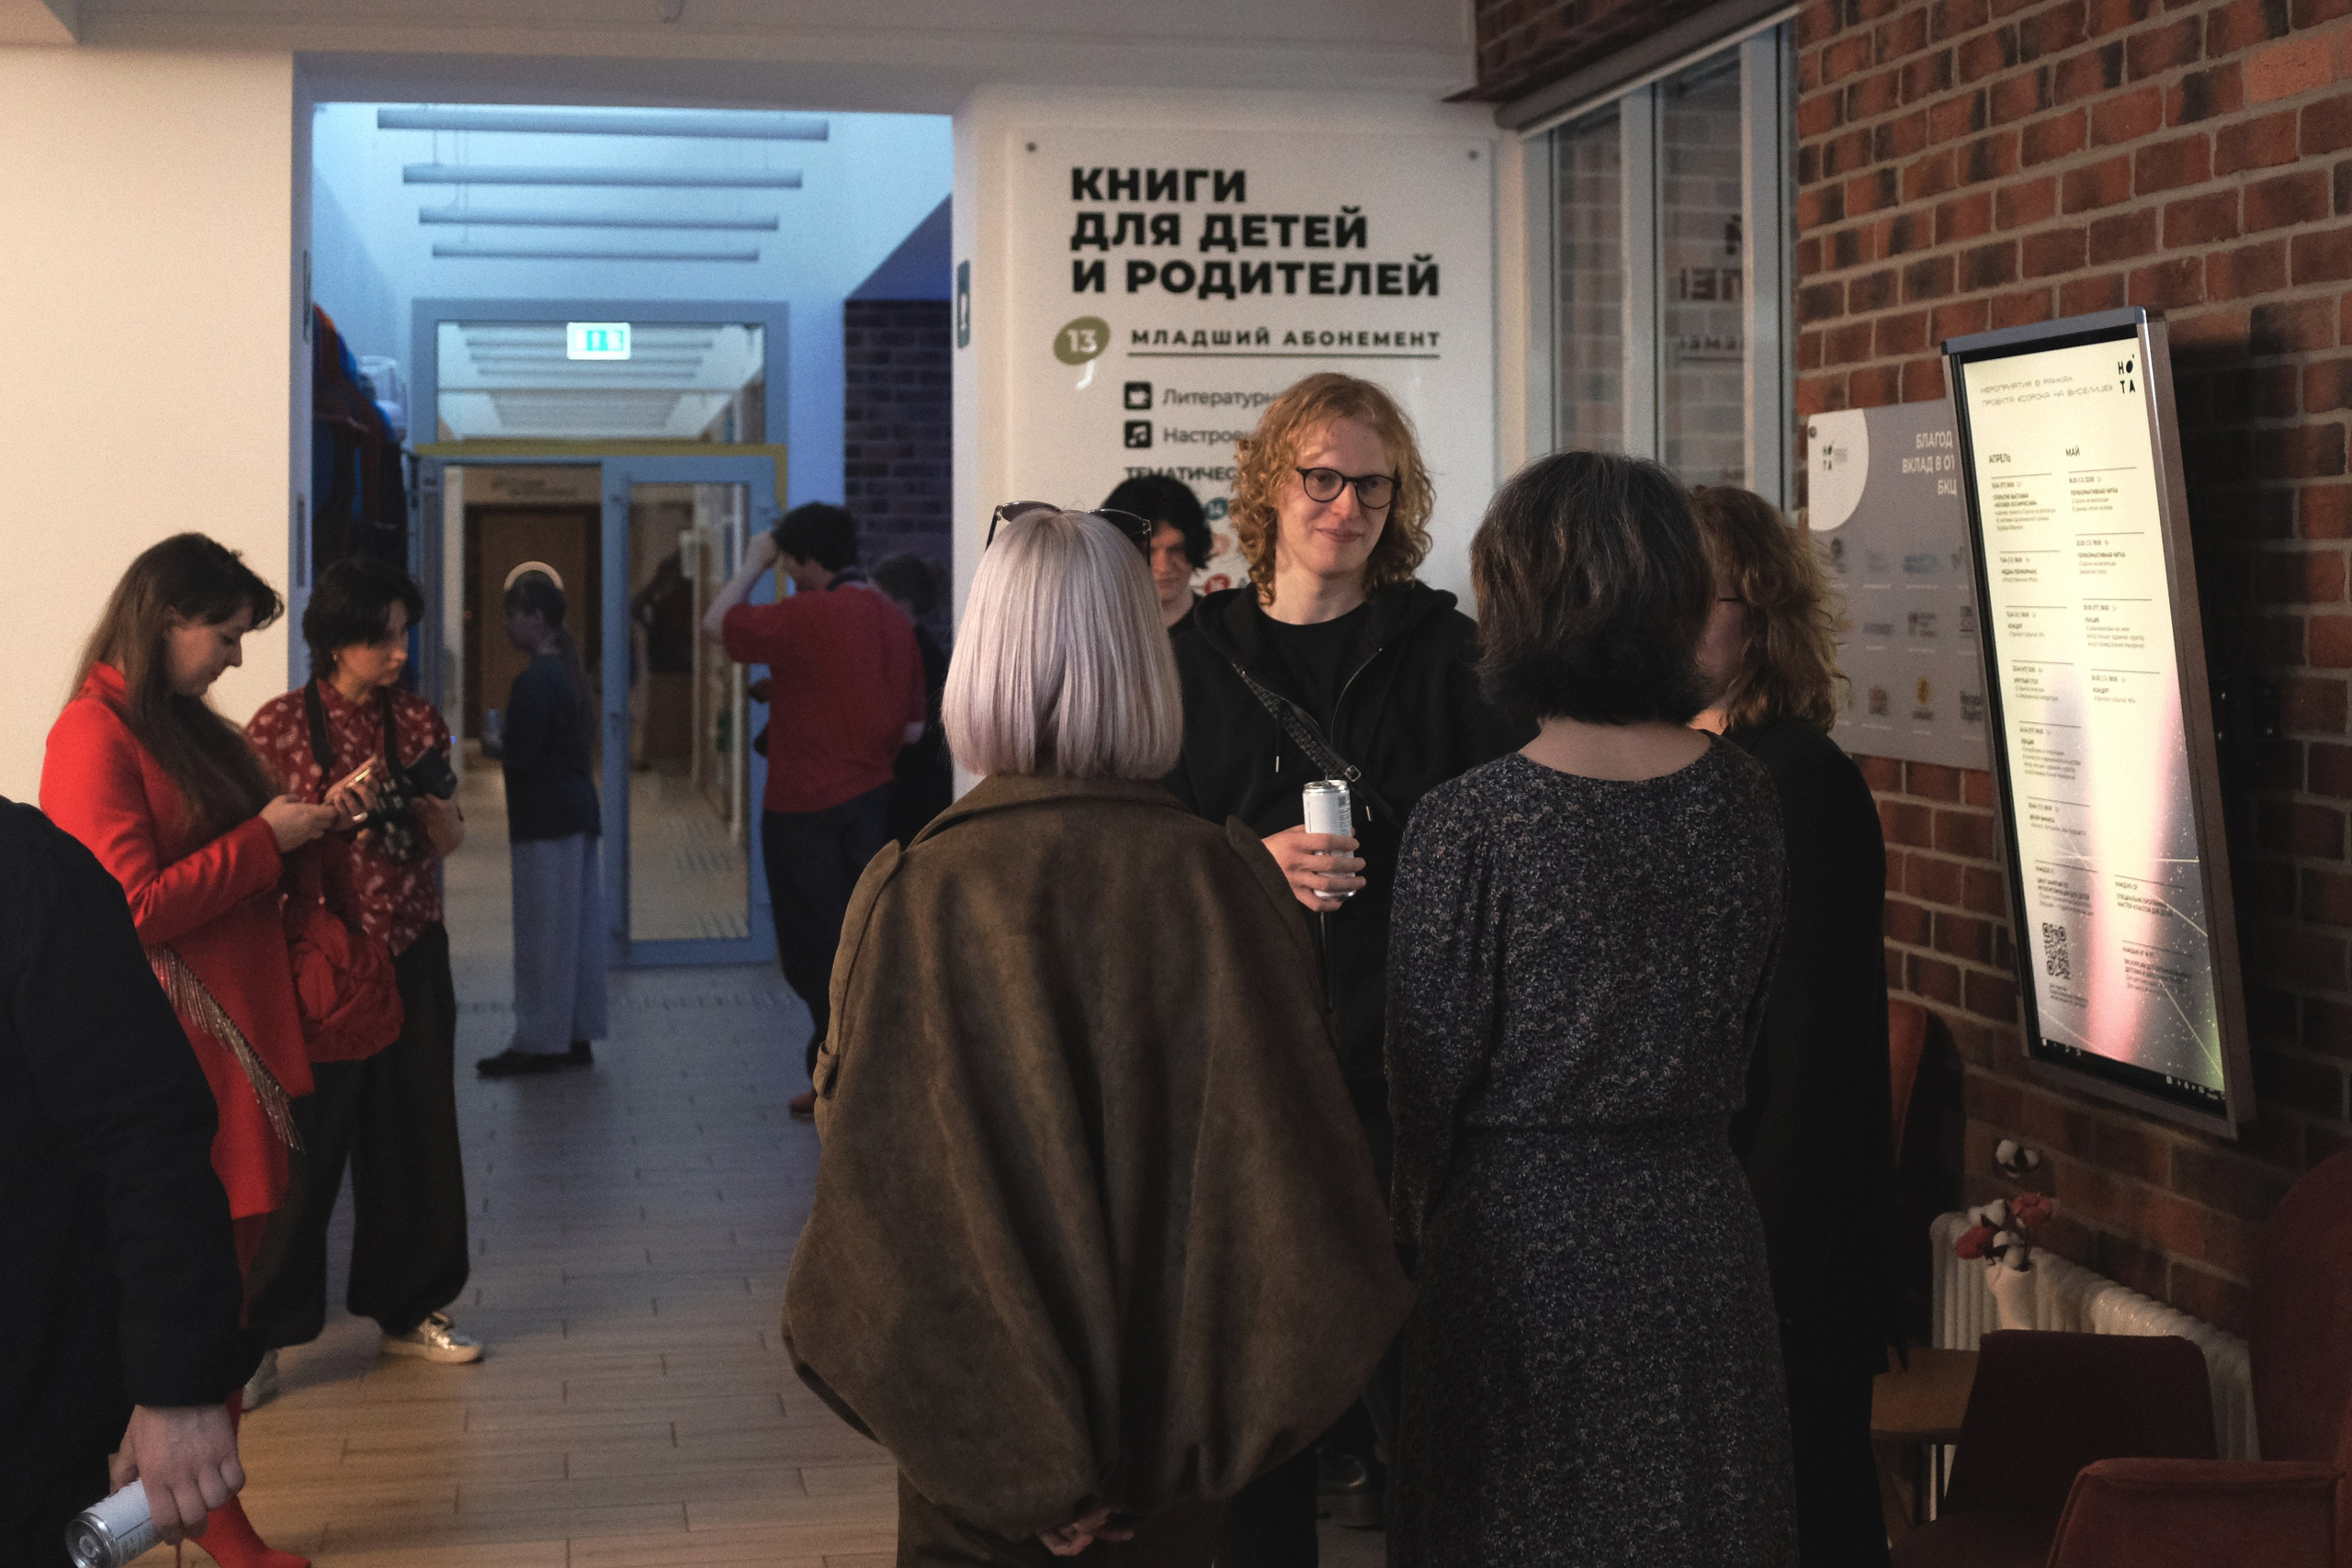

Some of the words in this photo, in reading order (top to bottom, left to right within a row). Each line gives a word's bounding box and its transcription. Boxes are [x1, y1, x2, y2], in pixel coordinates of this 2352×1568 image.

[1070, 167, 1246, 202] КНИГИ
[1070, 212, 1181, 251] ДЛЯ
[1200, 207, 1367, 253] ДЕТЕЙ
[1071, 260, 1106, 293] И
[1126, 254, 1440, 299] РОДИТЕЛЕЙ
[1066, 328, 1098, 354] 13
[1131, 327, 1271, 348] МЛАДШИЙ
[1283, 331, 1441, 347] АБОНЕМЕНТ
[1989, 453, 2011, 464] АПРЕЛЬ
[2065, 446, 2081, 457] МАЙ
[1902, 457, 1934, 474] ВКЛАД
[1935, 455, 1941, 471] В
